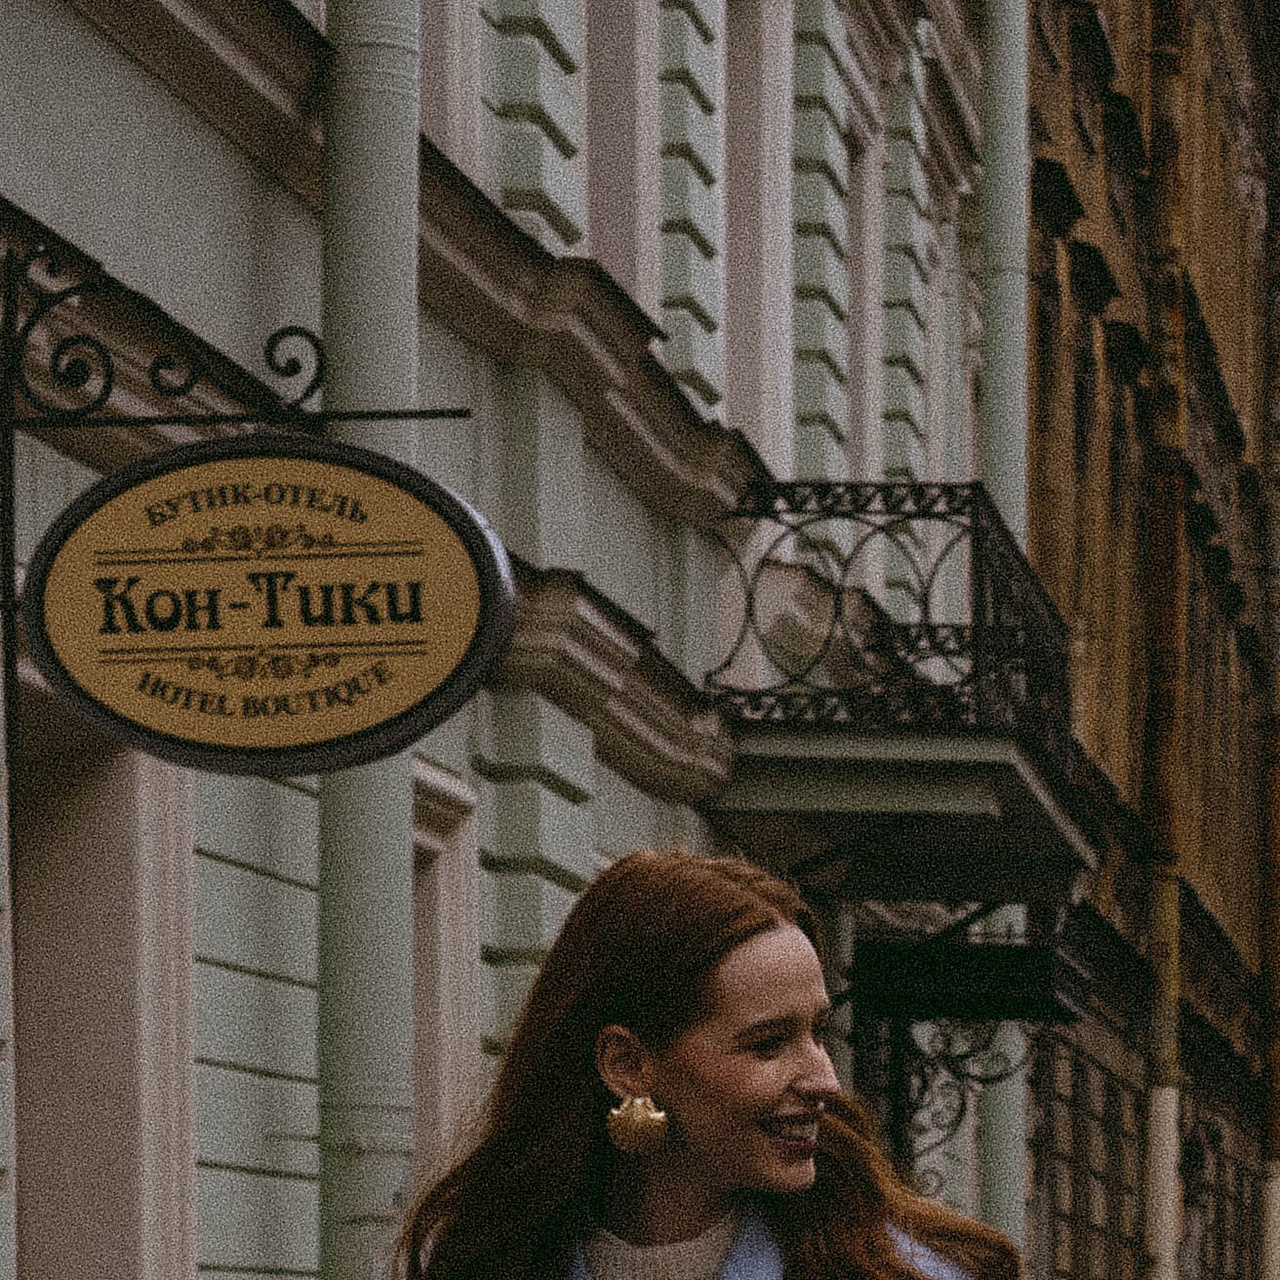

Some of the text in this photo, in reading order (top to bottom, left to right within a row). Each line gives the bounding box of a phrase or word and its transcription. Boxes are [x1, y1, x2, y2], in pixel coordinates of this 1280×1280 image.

[144, 482, 367, 527] БУТИК-ОТЕЛЬ
[94, 571, 423, 634] Кон-Тики
[137, 661, 394, 719] HOTEL BOUTIQUE
